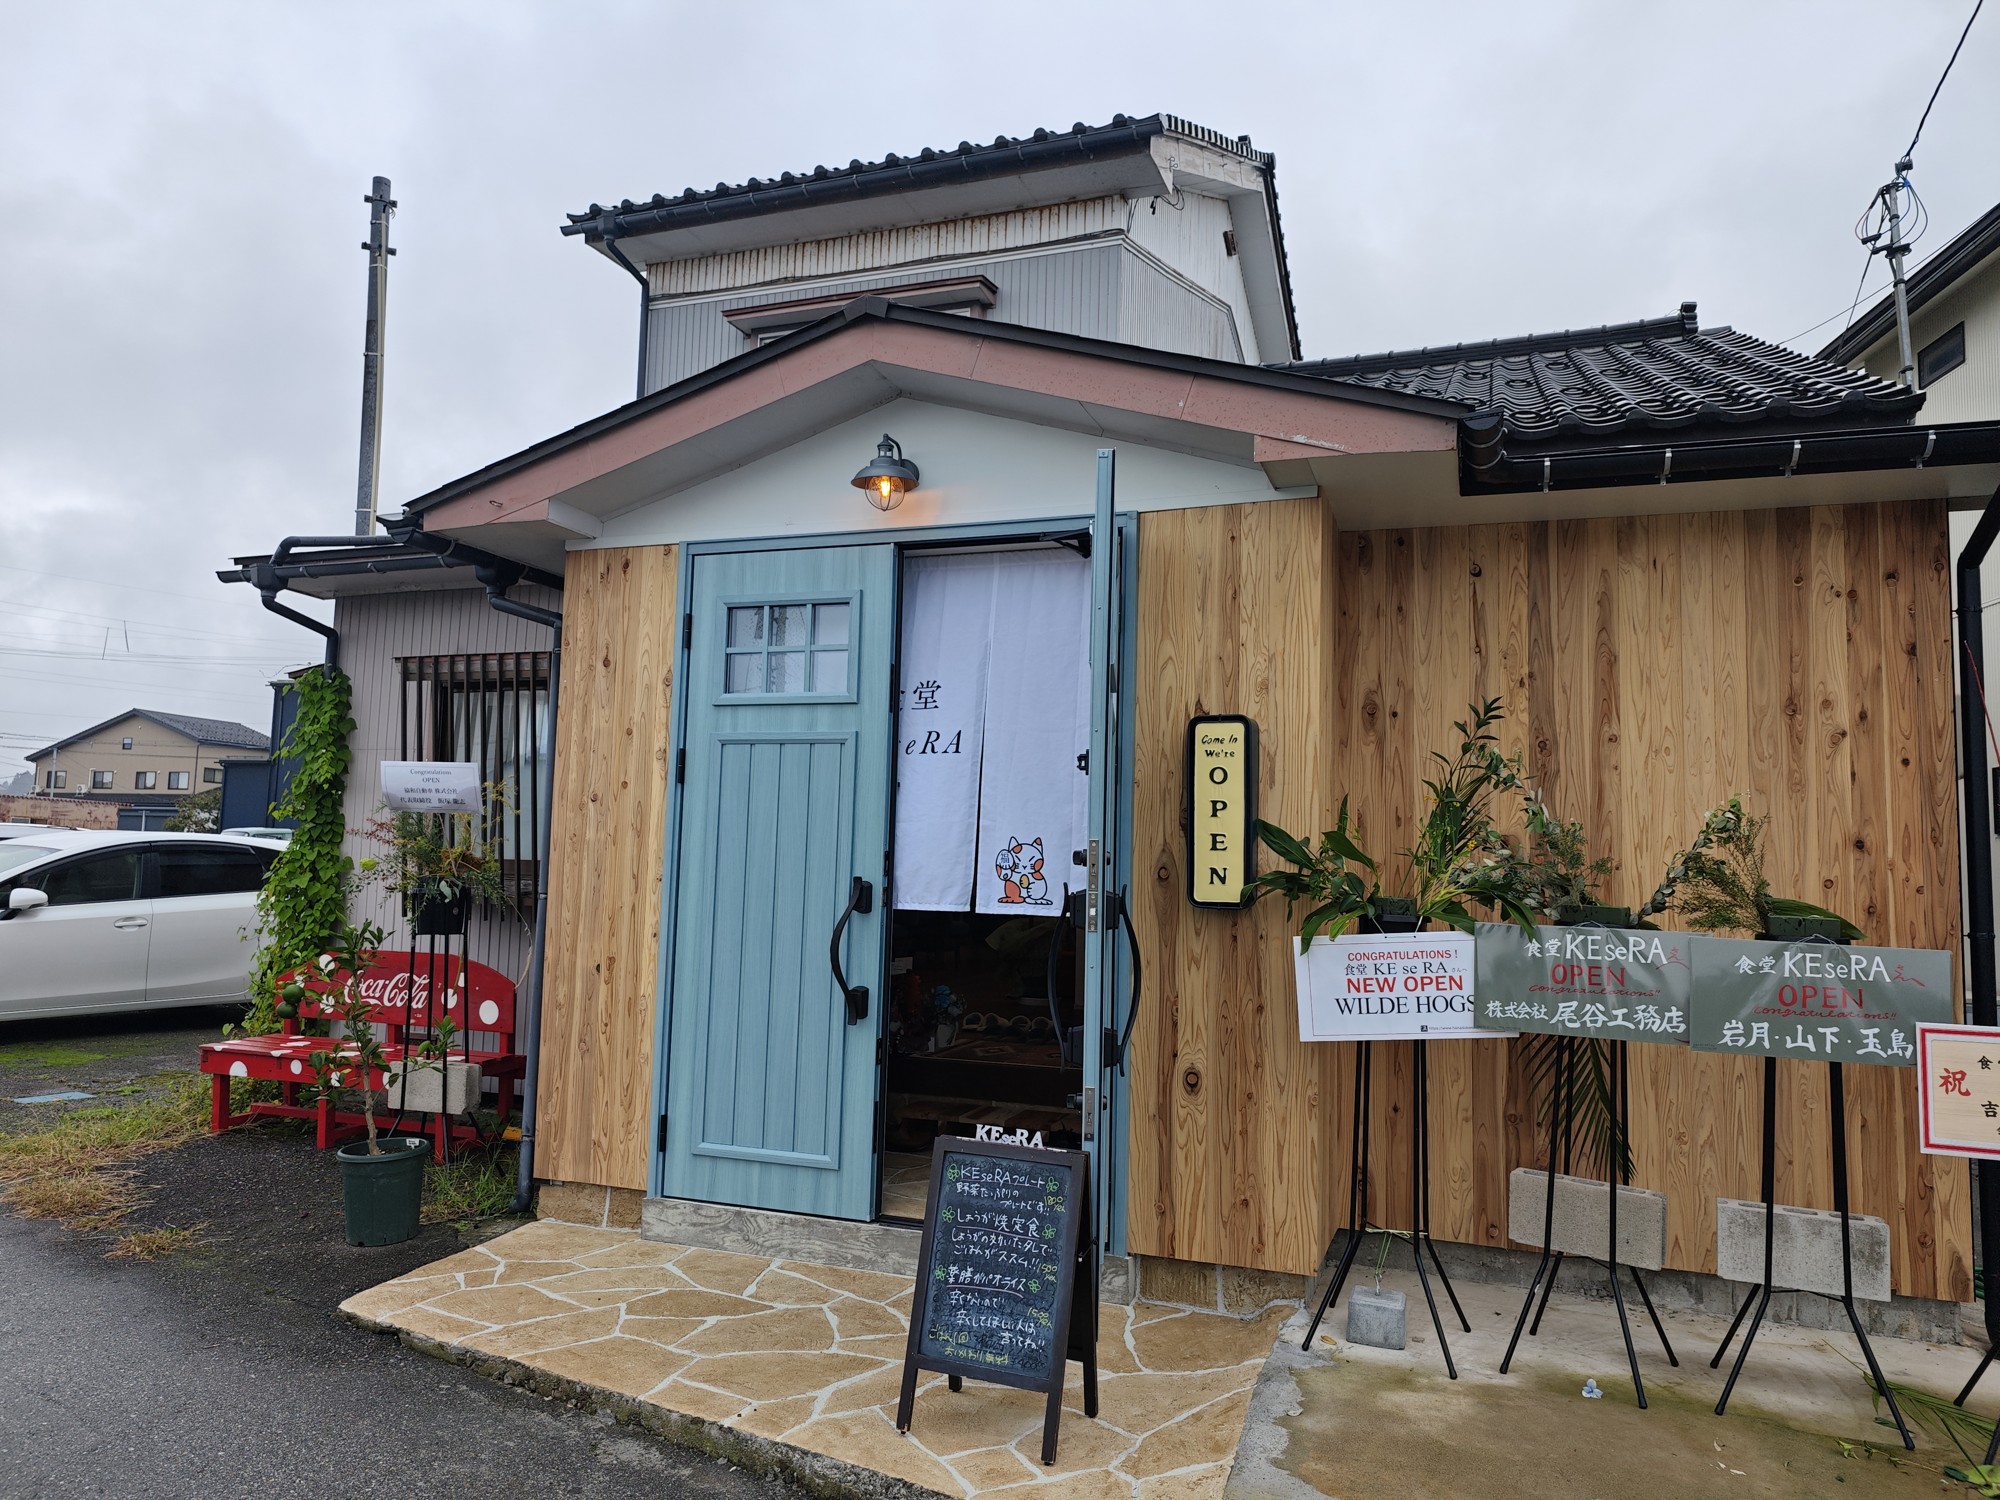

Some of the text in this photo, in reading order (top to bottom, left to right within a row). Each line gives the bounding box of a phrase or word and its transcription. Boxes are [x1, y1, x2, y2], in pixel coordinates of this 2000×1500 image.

[900, 680, 942, 710] 堂
[899, 729, 962, 755] eRA
[1201, 734, 1238, 745] Come In
[1205, 749, 1235, 758] We're
[1209, 766, 1228, 885] OPEN
[1345, 963, 1367, 976] 食堂
[1374, 962, 1397, 975] KE
[1422, 961, 1448, 974] RA
[1551, 963, 1625, 987] OPEN
[1346, 975, 1463, 994] NEW OPEN
[1778, 984, 1864, 1009] OPEN
[1335, 994, 1474, 1015] WILDE HOGS
[1978, 1056, 2000, 1070] 食
[1939, 1067, 1971, 1097] 祝
[975, 1123, 1046, 1150] KEseRA
